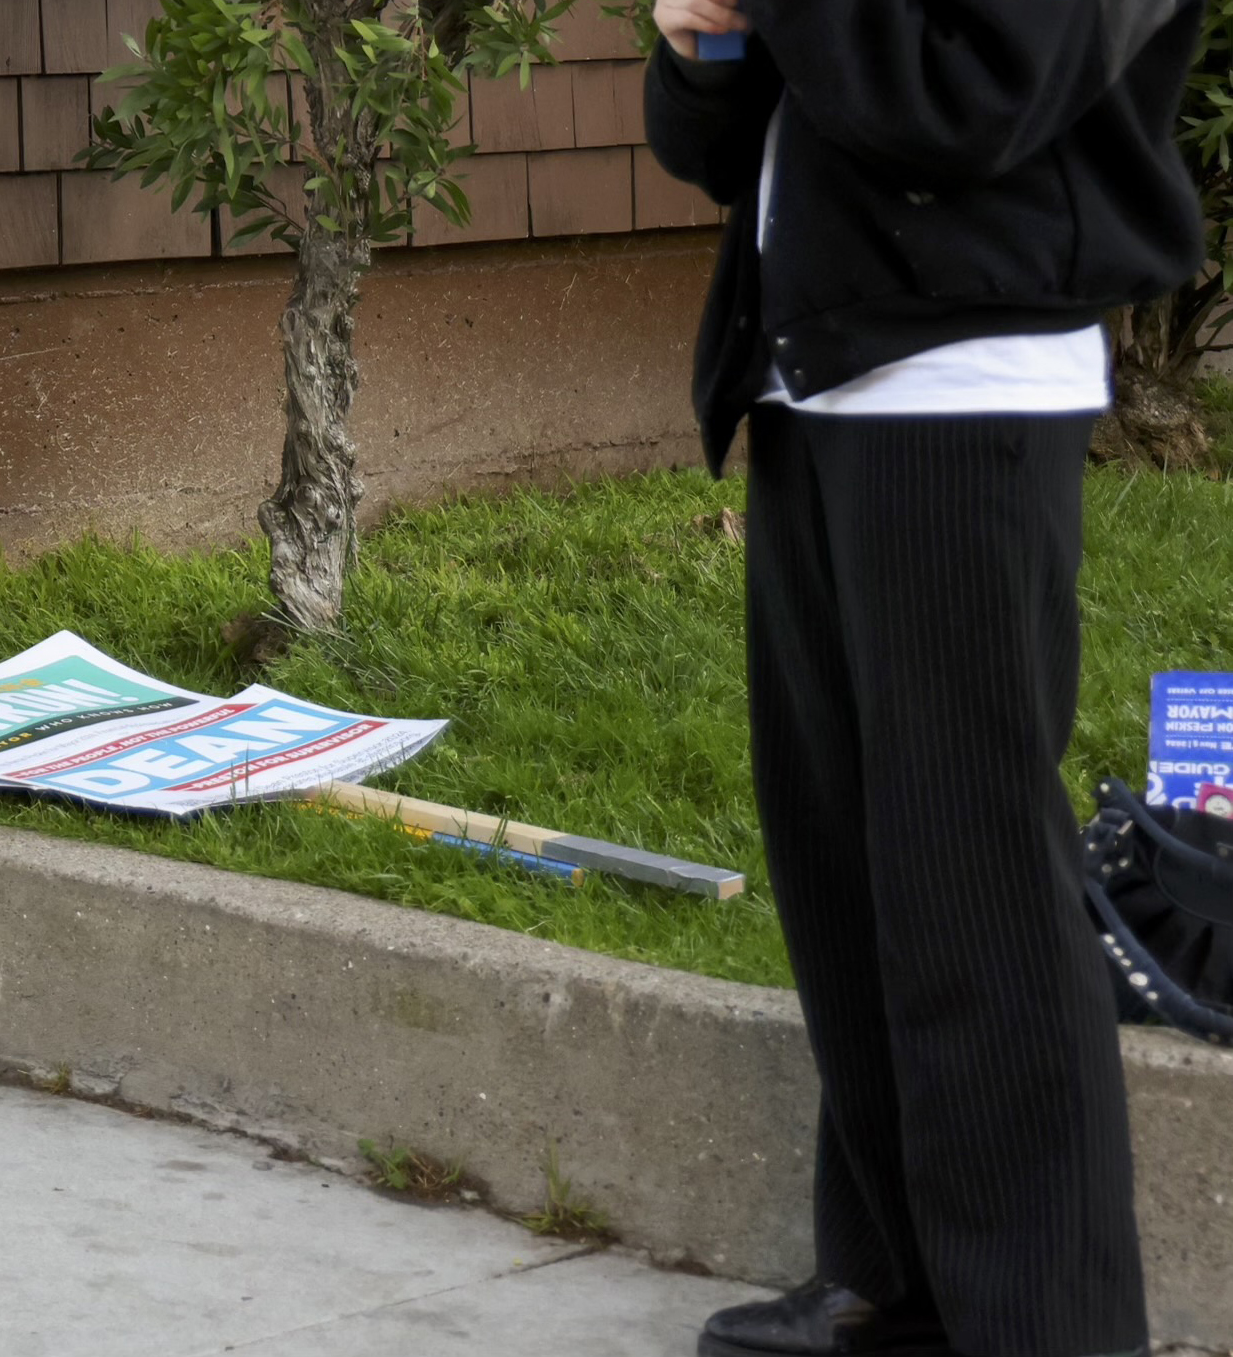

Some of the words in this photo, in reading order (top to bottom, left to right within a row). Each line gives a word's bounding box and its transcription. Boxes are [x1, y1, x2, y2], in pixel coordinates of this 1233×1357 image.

[35, 717, 74, 733] WHO
[77, 707, 135, 721] KNOWS
[1167, 705, 1233, 720] MAYOR
[1165, 722, 1214, 733] PESKIN
[20, 764, 48, 778] FOR
[49, 756, 72, 770] THE
[73, 742, 123, 764] PEOPLE,
[122, 733, 147, 748] NOT
[146, 724, 171, 740] THE
[170, 708, 236, 732] POWERFUL
[46, 705, 341, 796] DEAN
[255, 755, 290, 767] FOR
[288, 722, 374, 759] SUPERVISOR
[1158, 761, 1231, 776] GUIDE
